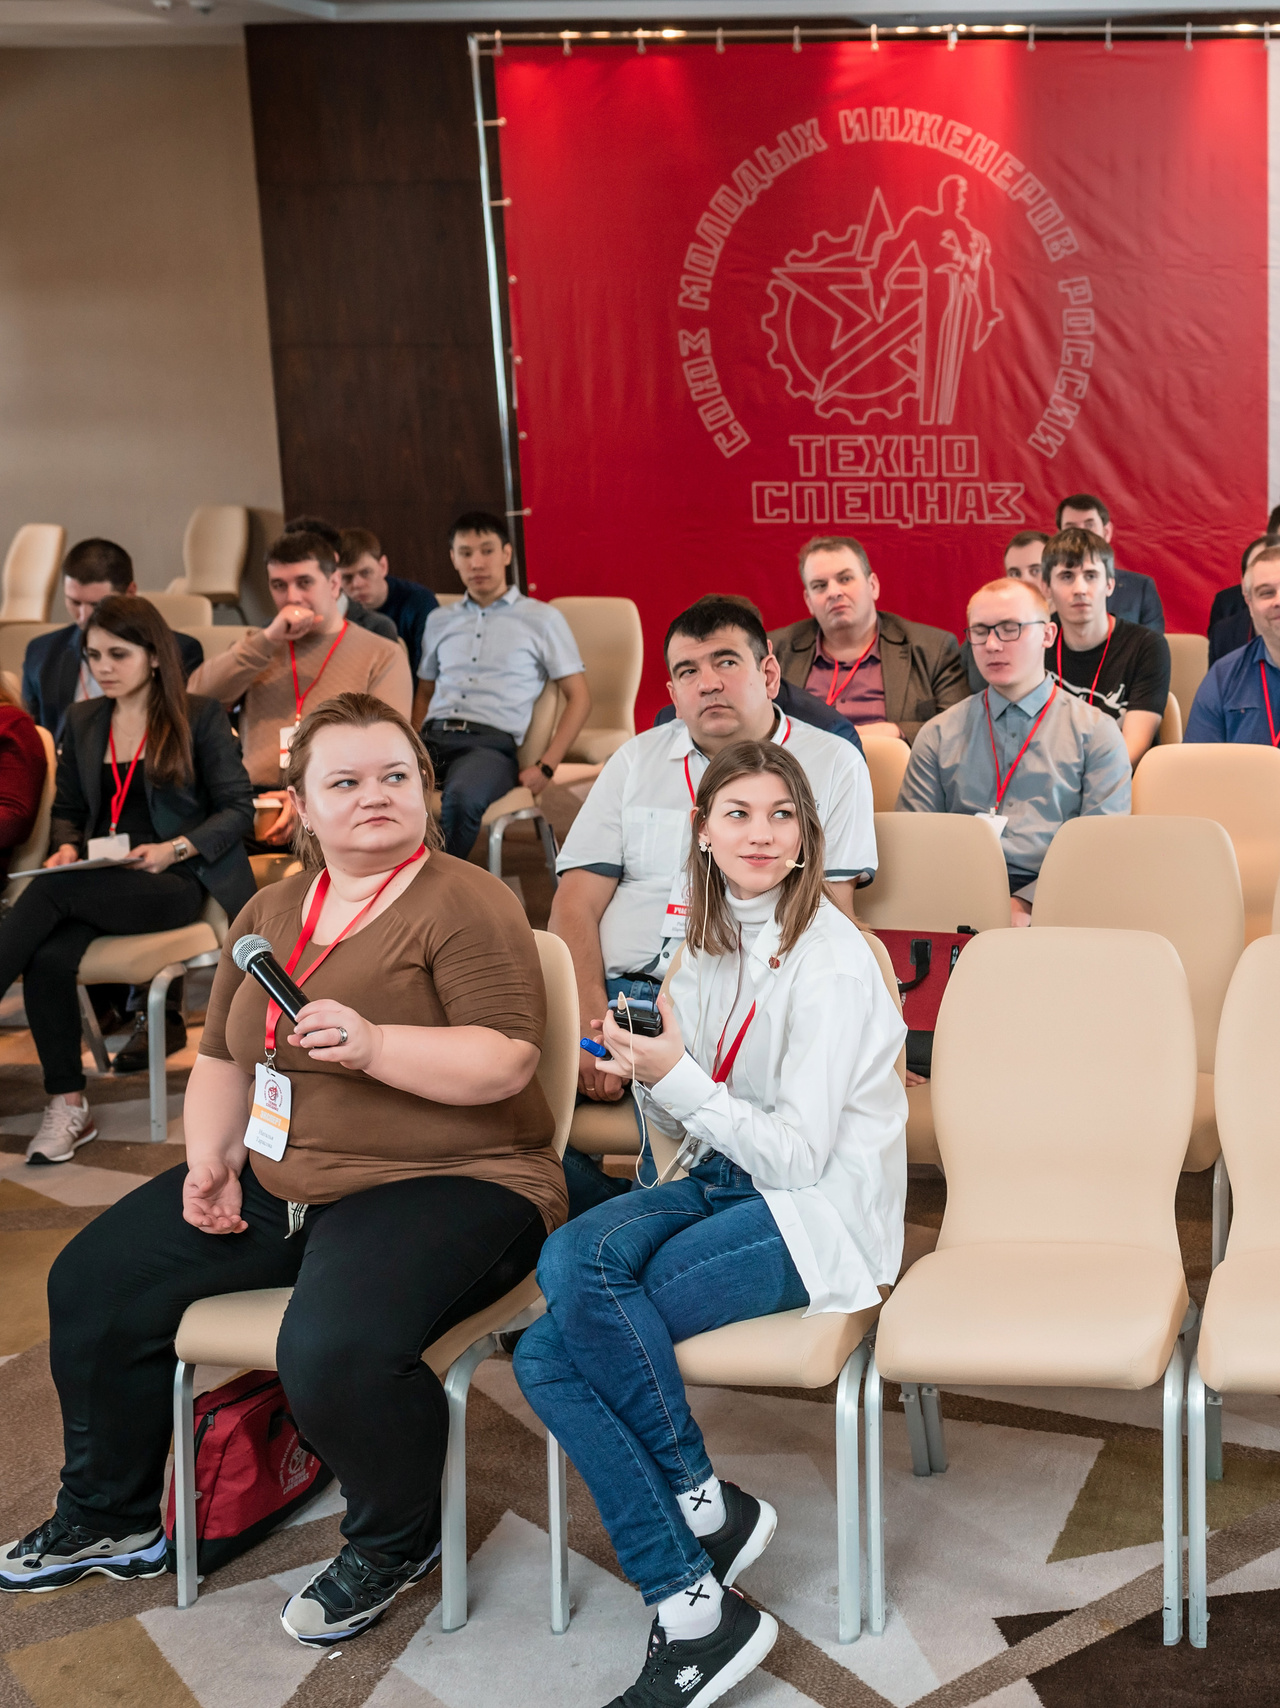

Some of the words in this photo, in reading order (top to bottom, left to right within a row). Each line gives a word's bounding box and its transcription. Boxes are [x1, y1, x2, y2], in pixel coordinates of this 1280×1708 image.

[678, 117, 829, 311] МОЛОДЫХ
[838, 106, 1081, 263] ИНЖЕНЕРОВ
[678, 326, 752, 459] СОЮЗ
[1027, 275, 1096, 459] РОССИИ
[752, 481, 1026, 529] СПЕЦНАЗ
[789, 434, 979, 478] ТЕХНО
